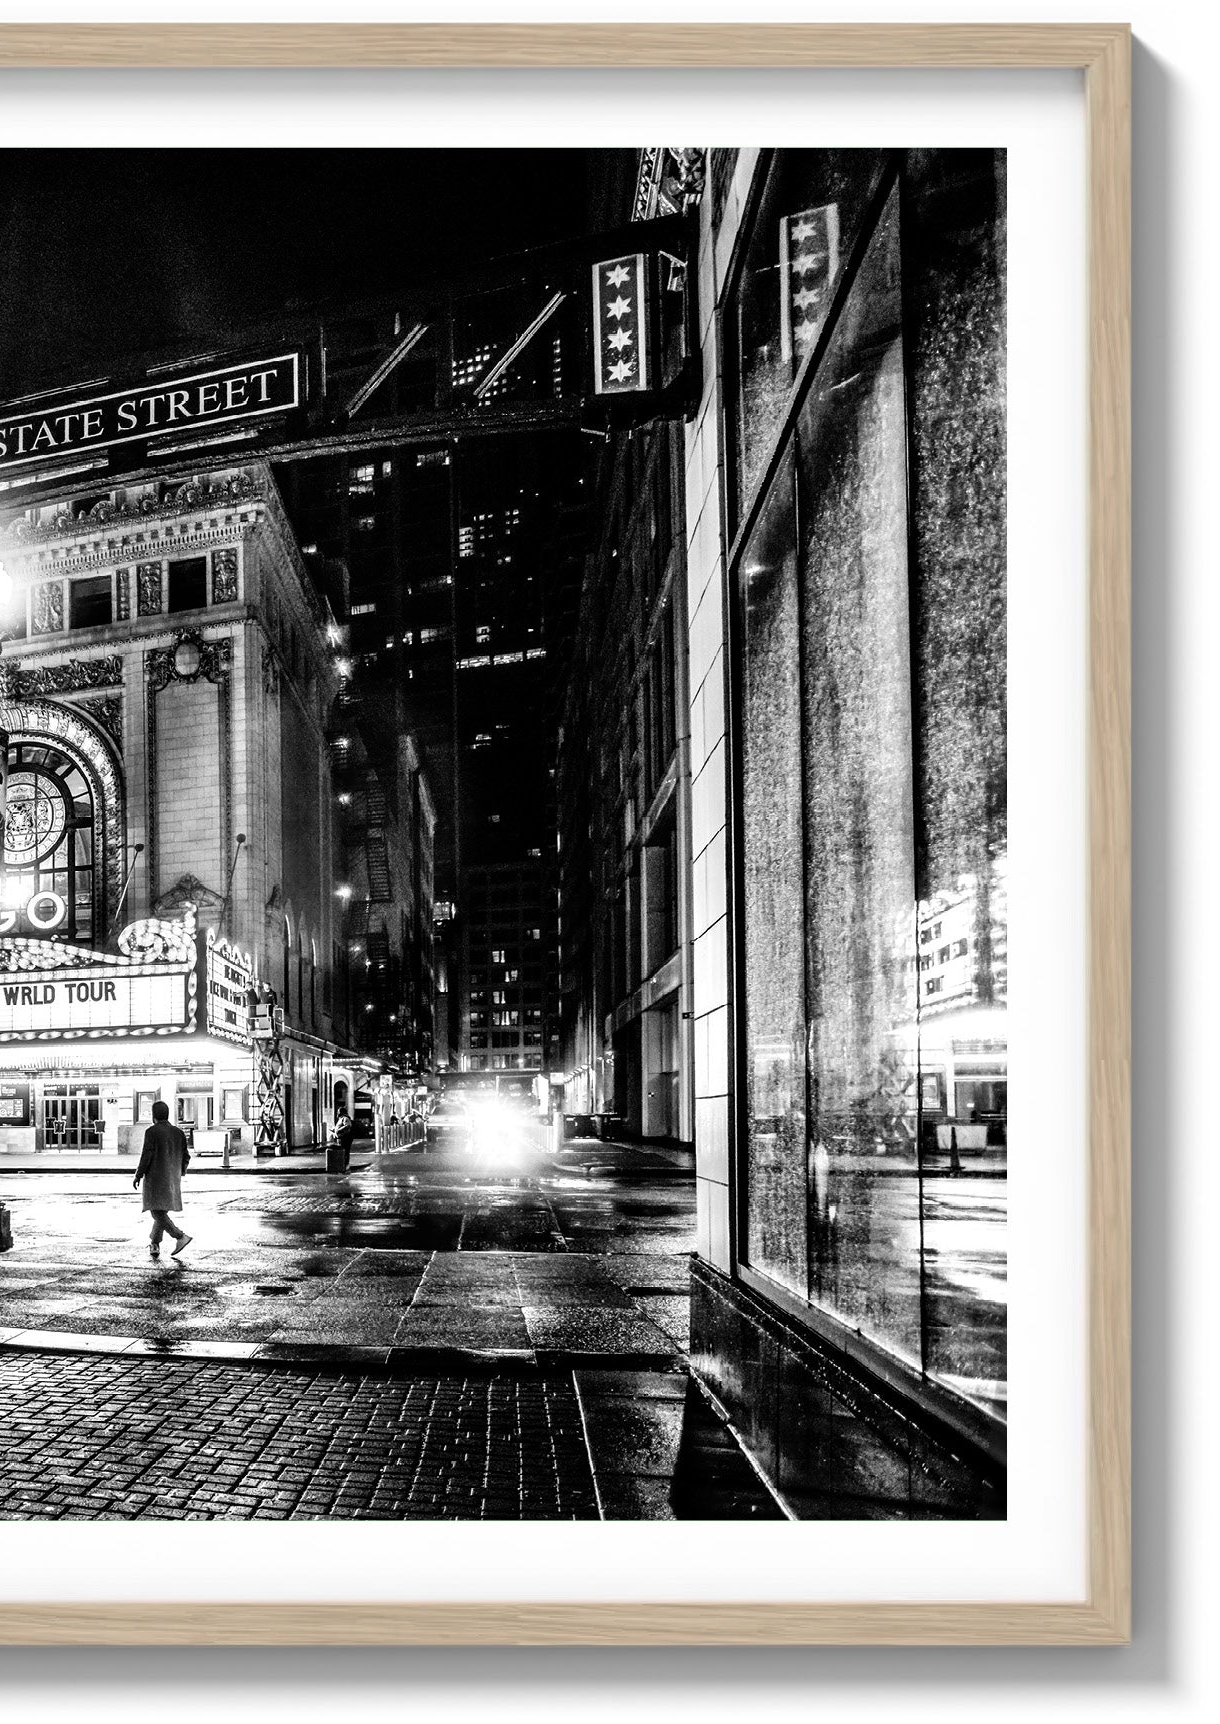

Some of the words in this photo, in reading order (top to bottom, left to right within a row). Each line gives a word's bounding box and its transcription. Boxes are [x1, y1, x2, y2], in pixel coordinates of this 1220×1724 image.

[117, 369, 278, 432] STREET
[3, 984, 56, 1006] WRLD
[64, 980, 117, 1004] TOUR
